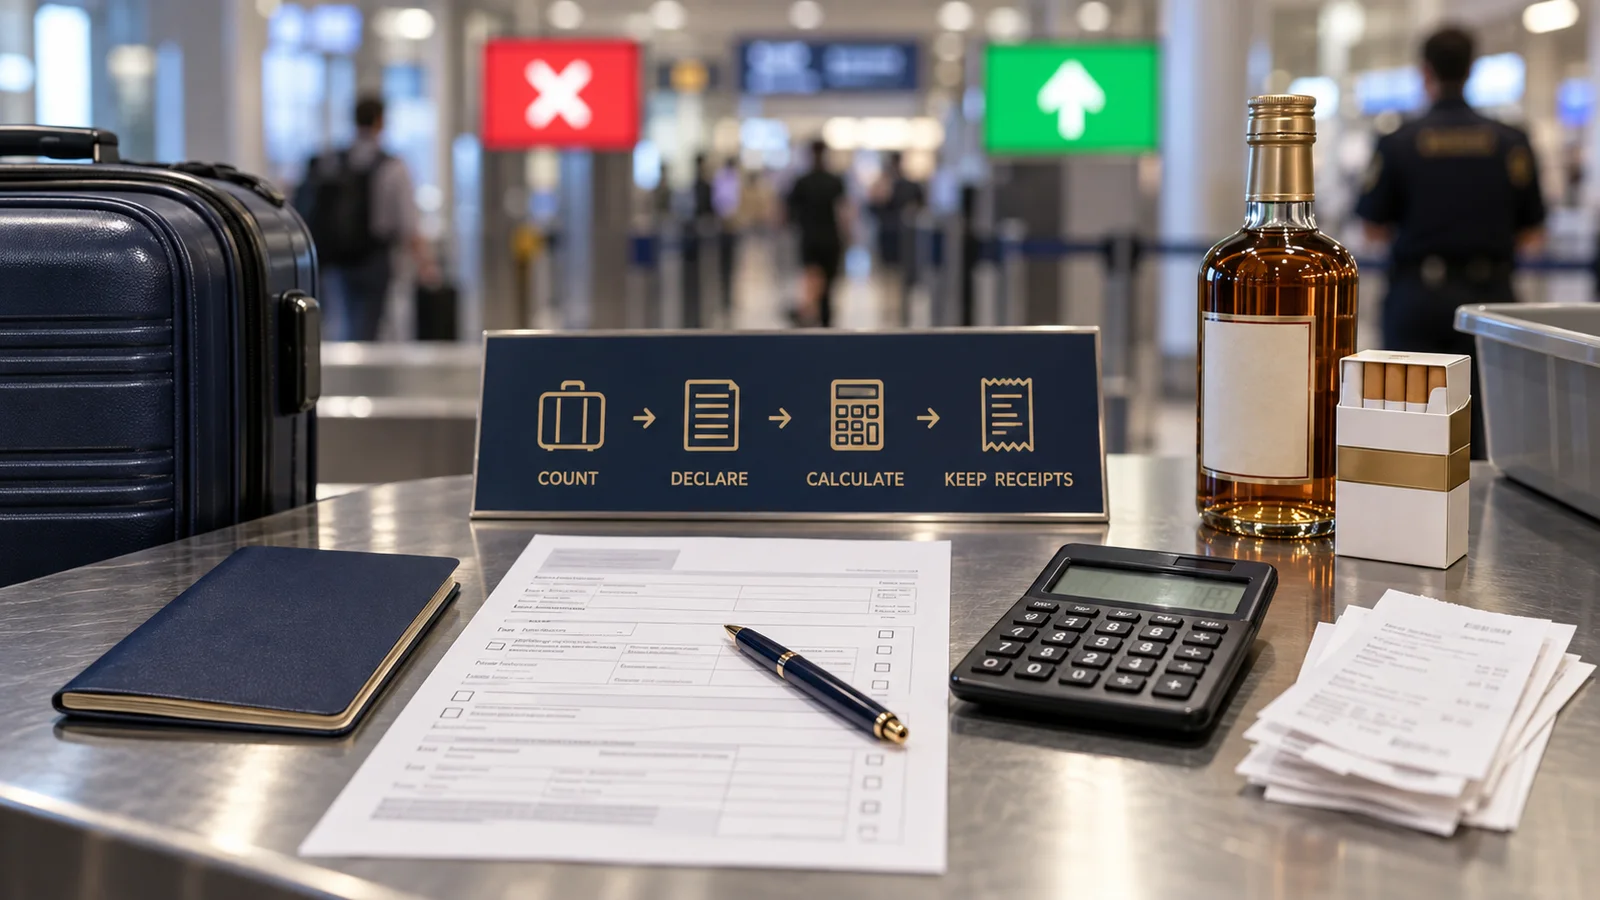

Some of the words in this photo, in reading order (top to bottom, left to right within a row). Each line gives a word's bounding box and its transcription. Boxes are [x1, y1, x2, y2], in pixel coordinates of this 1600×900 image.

[537, 470, 599, 486] COUNT
[671, 471, 748, 486] DECLARE
[806, 471, 905, 487] CALCULATE
[944, 471, 987, 487] KEEP
[995, 471, 1074, 487] RECEIPTS
